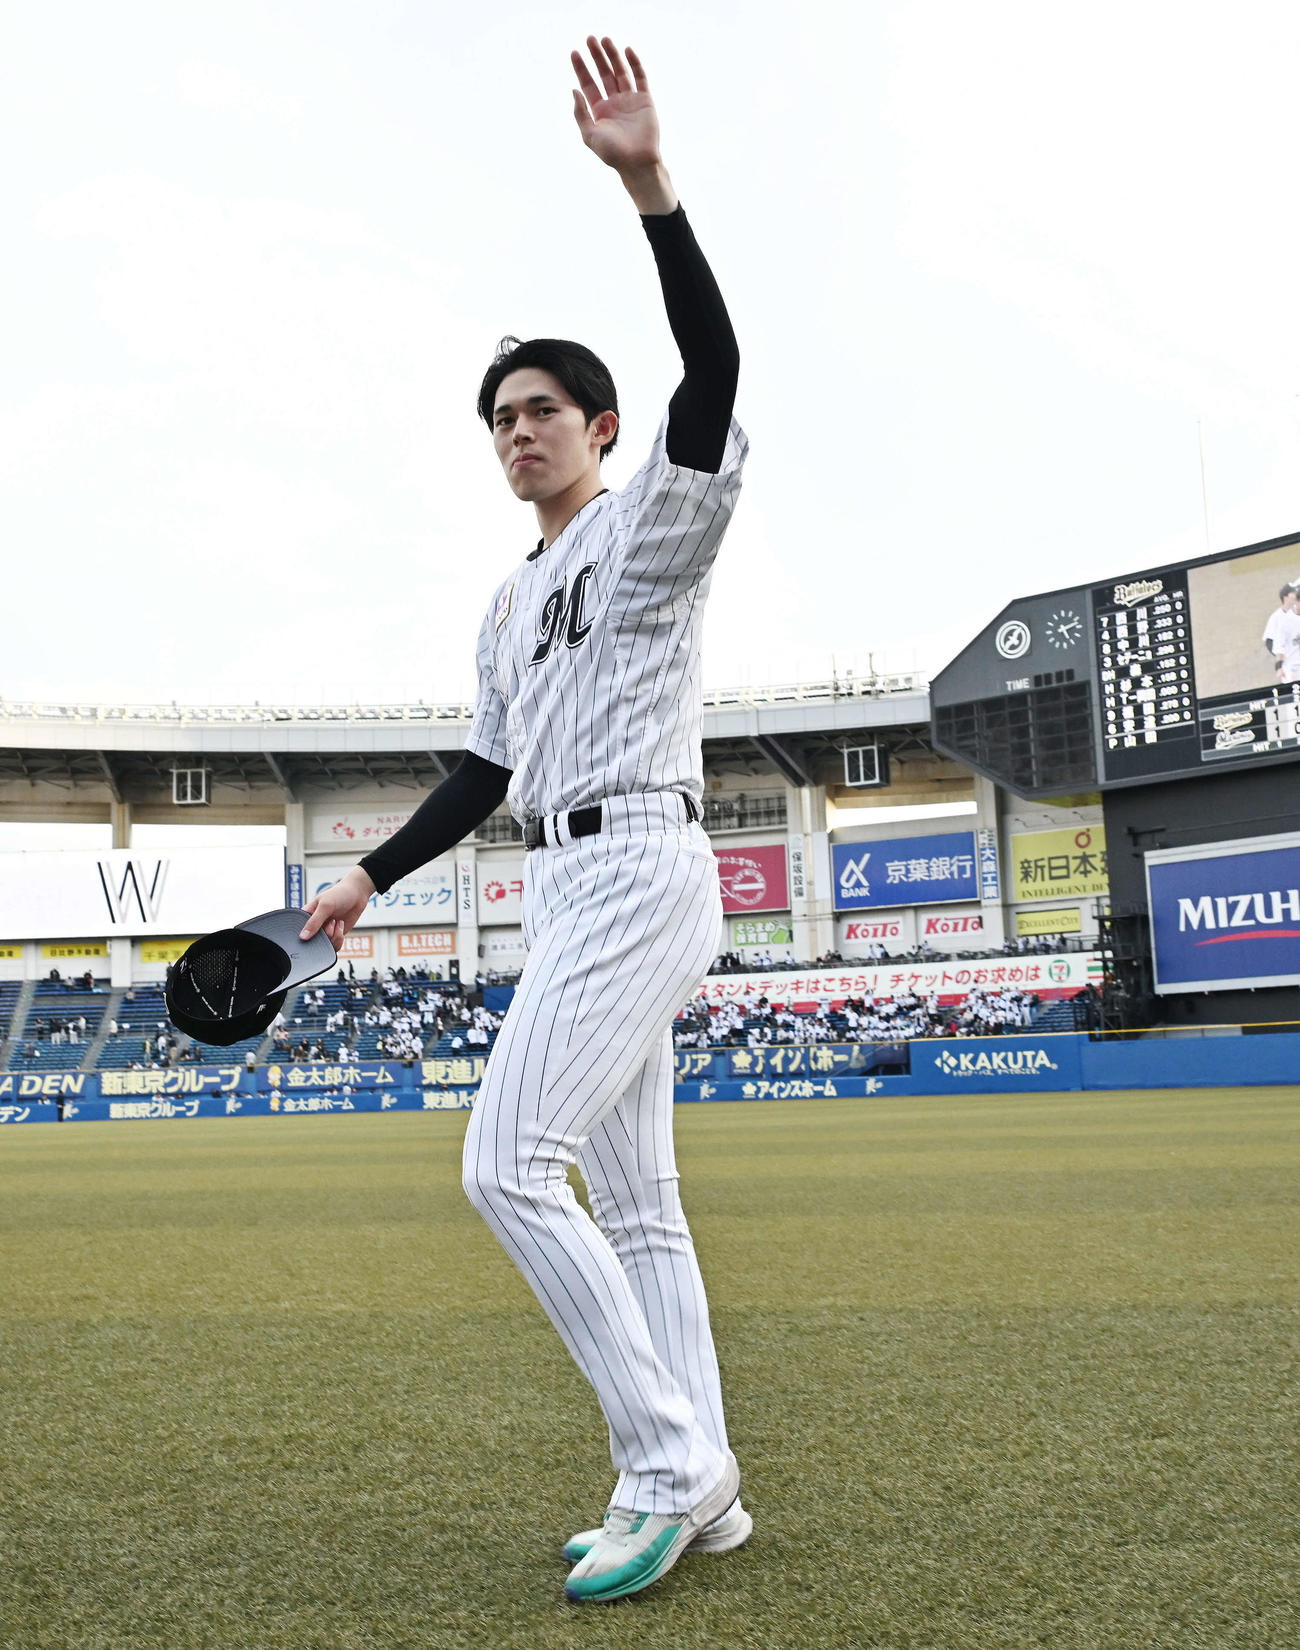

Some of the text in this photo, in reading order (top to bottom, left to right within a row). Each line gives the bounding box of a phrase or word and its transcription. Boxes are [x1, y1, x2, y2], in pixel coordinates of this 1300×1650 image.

[528, 562, 598, 668] M
[1006, 678, 1030, 691] TIME
[886, 855, 973, 884] 京葉銀行
[841, 888, 870, 898] BANK
[960, 1050, 1052, 1070] KAKUTA
[101, 1066, 242, 1095] 新東京グループ
[286, 1066, 394, 1087] 金太郎ホーム
[110, 1100, 200, 1120] 新東京グループ
[283, 1098, 355, 1112] 金太郎ホーム
